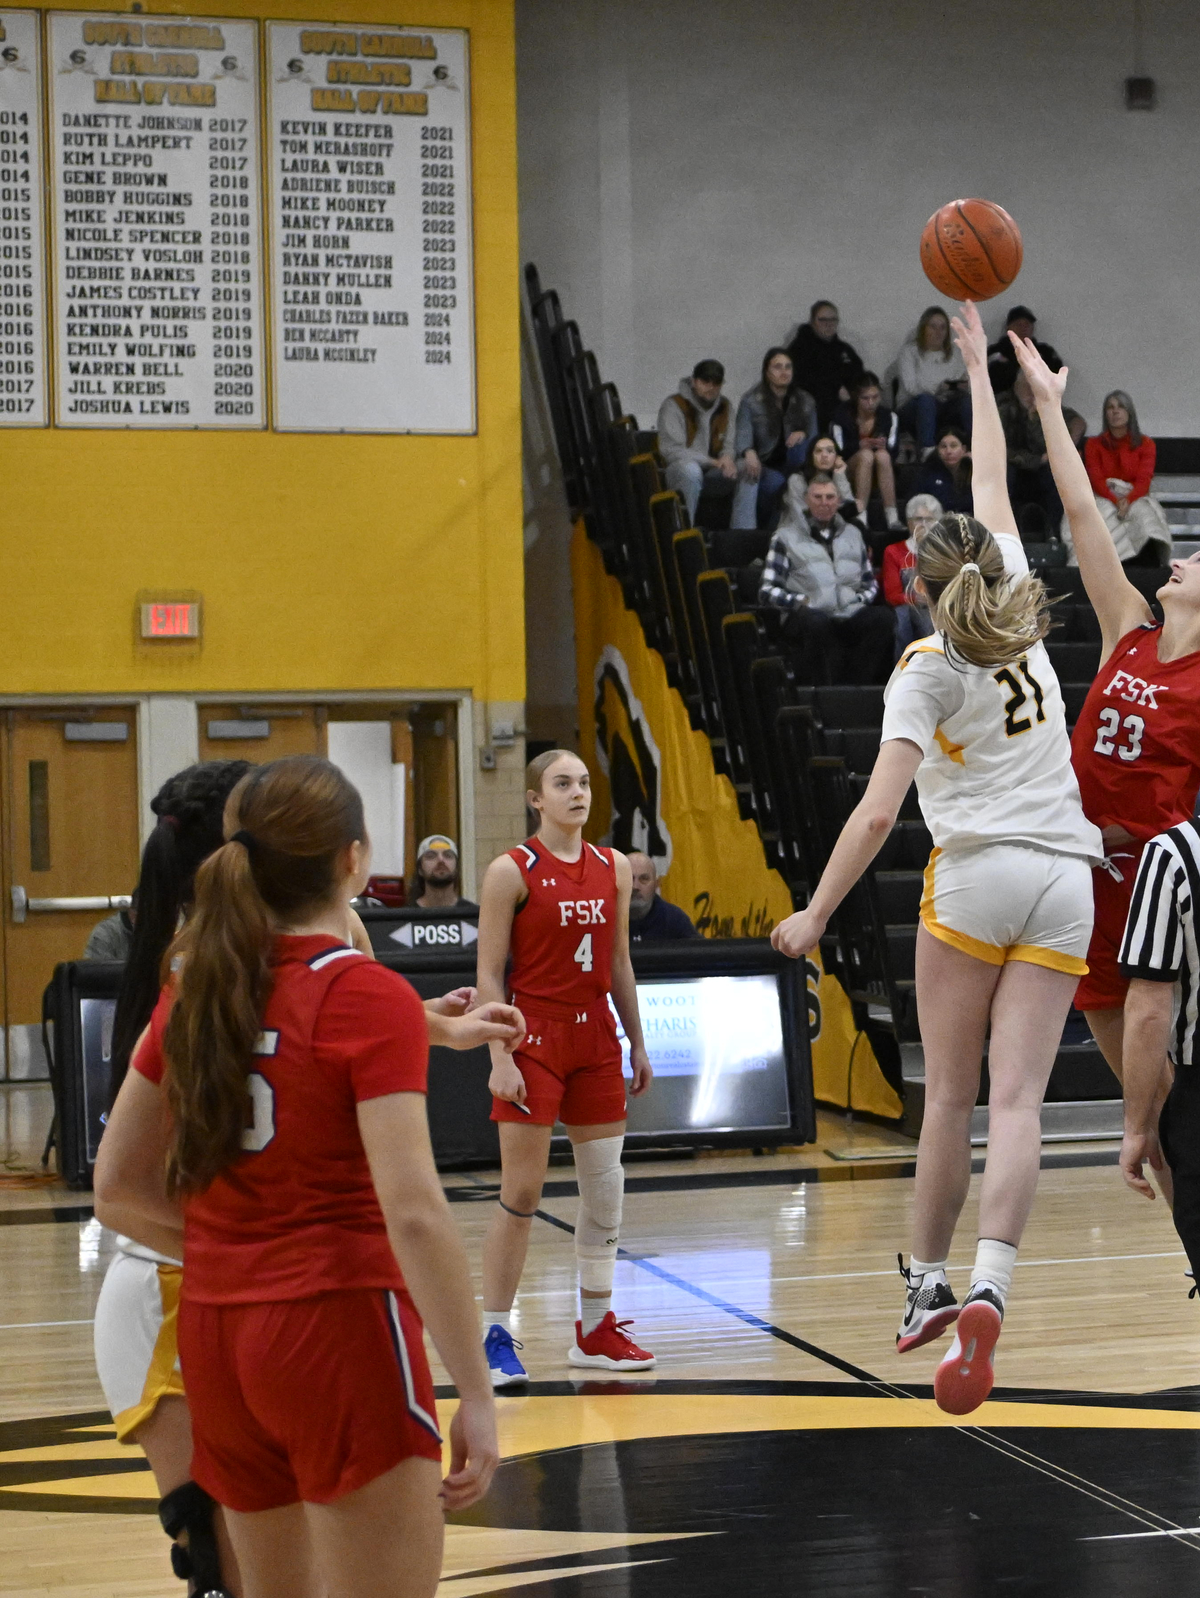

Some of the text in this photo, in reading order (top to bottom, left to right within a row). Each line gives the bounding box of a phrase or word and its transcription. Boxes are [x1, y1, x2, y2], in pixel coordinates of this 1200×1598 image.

[0, 111, 28, 126] 014
[62, 112, 248, 133] DANETTE JOHNSON 2017
[0, 130, 28, 144] 014
[280, 120, 454, 142] KEVIN KEEFER 2021
[63, 132, 248, 152] RUTH LAMPERT 2017
[279, 139, 309, 155] TOM
[420, 144, 454, 160] 2021
[0, 149, 29, 164] 014
[62, 151, 249, 171] KIM LEPPO 2017
[0, 169, 30, 183] 014
[280, 157, 454, 179] LAURA WISER 2021
[63, 170, 249, 190] GENE BROWN 2018
[0, 188, 30, 202] 015
[421, 181, 455, 198] 2022
[63, 189, 249, 209] BOBBY HUGGINS 2018
[281, 195, 455, 216] MIKE MOONEY 2022
[0, 207, 30, 220] 015
[64, 209, 250, 227] MIKE JENKINS 2018
[0, 226, 31, 240] 015
[281, 214, 456, 235] NANCY PARKER 2022
[64, 227, 250, 246] NICOLE SPENCER 2018
[281, 233, 456, 253] JIM HORN 2023
[0, 245, 31, 258] 015
[65, 246, 135, 262] LINDSEY
[210, 249, 251, 265] 2018
[282, 251, 456, 272] RYAN MCTAVISH 2023
[0, 264, 32, 278] 015
[65, 265, 251, 284] DEBBIE BARNES 2019
[282, 270, 457, 291] DANNY MULLEN 2023
[0, 284, 32, 298] 016
[65, 285, 252, 303] JAMES COSTLEY 2019
[282, 289, 321, 306] LEAH
[423, 293, 457, 310] 2023
[0, 302, 33, 316] 016
[66, 304, 252, 322] ANTHONY NORRIS 2019
[282, 308, 332, 325] CHARLES
[372, 310, 409, 327] BAKER
[423, 312, 451, 328] 2024
[0, 322, 33, 336] 016
[66, 322, 252, 340] KENDRA PULIS 2019
[424, 330, 452, 346] 2024
[0, 341, 33, 355] 016
[67, 341, 253, 359] EMILY WOLFING 2019
[283, 346, 320, 362] LAURA
[424, 349, 452, 365] 2024
[0, 360, 34, 374] 016
[68, 361, 254, 378] WARREN BELL 2020
[0, 379, 34, 393] 017
[67, 379, 107, 395] JILL
[213, 381, 254, 397] 2020
[0, 398, 34, 412] 017
[68, 399, 254, 416] JOSHUA LEWIS 2020
[151, 604, 190, 635] EXIT
[993, 653, 1046, 739] 21
[1103, 670, 1169, 710] FSK
[1093, 707, 1146, 762] 23
[558, 899, 606, 927] FSK
[413, 924, 460, 944] POSS
[573, 933, 593, 972] 4
